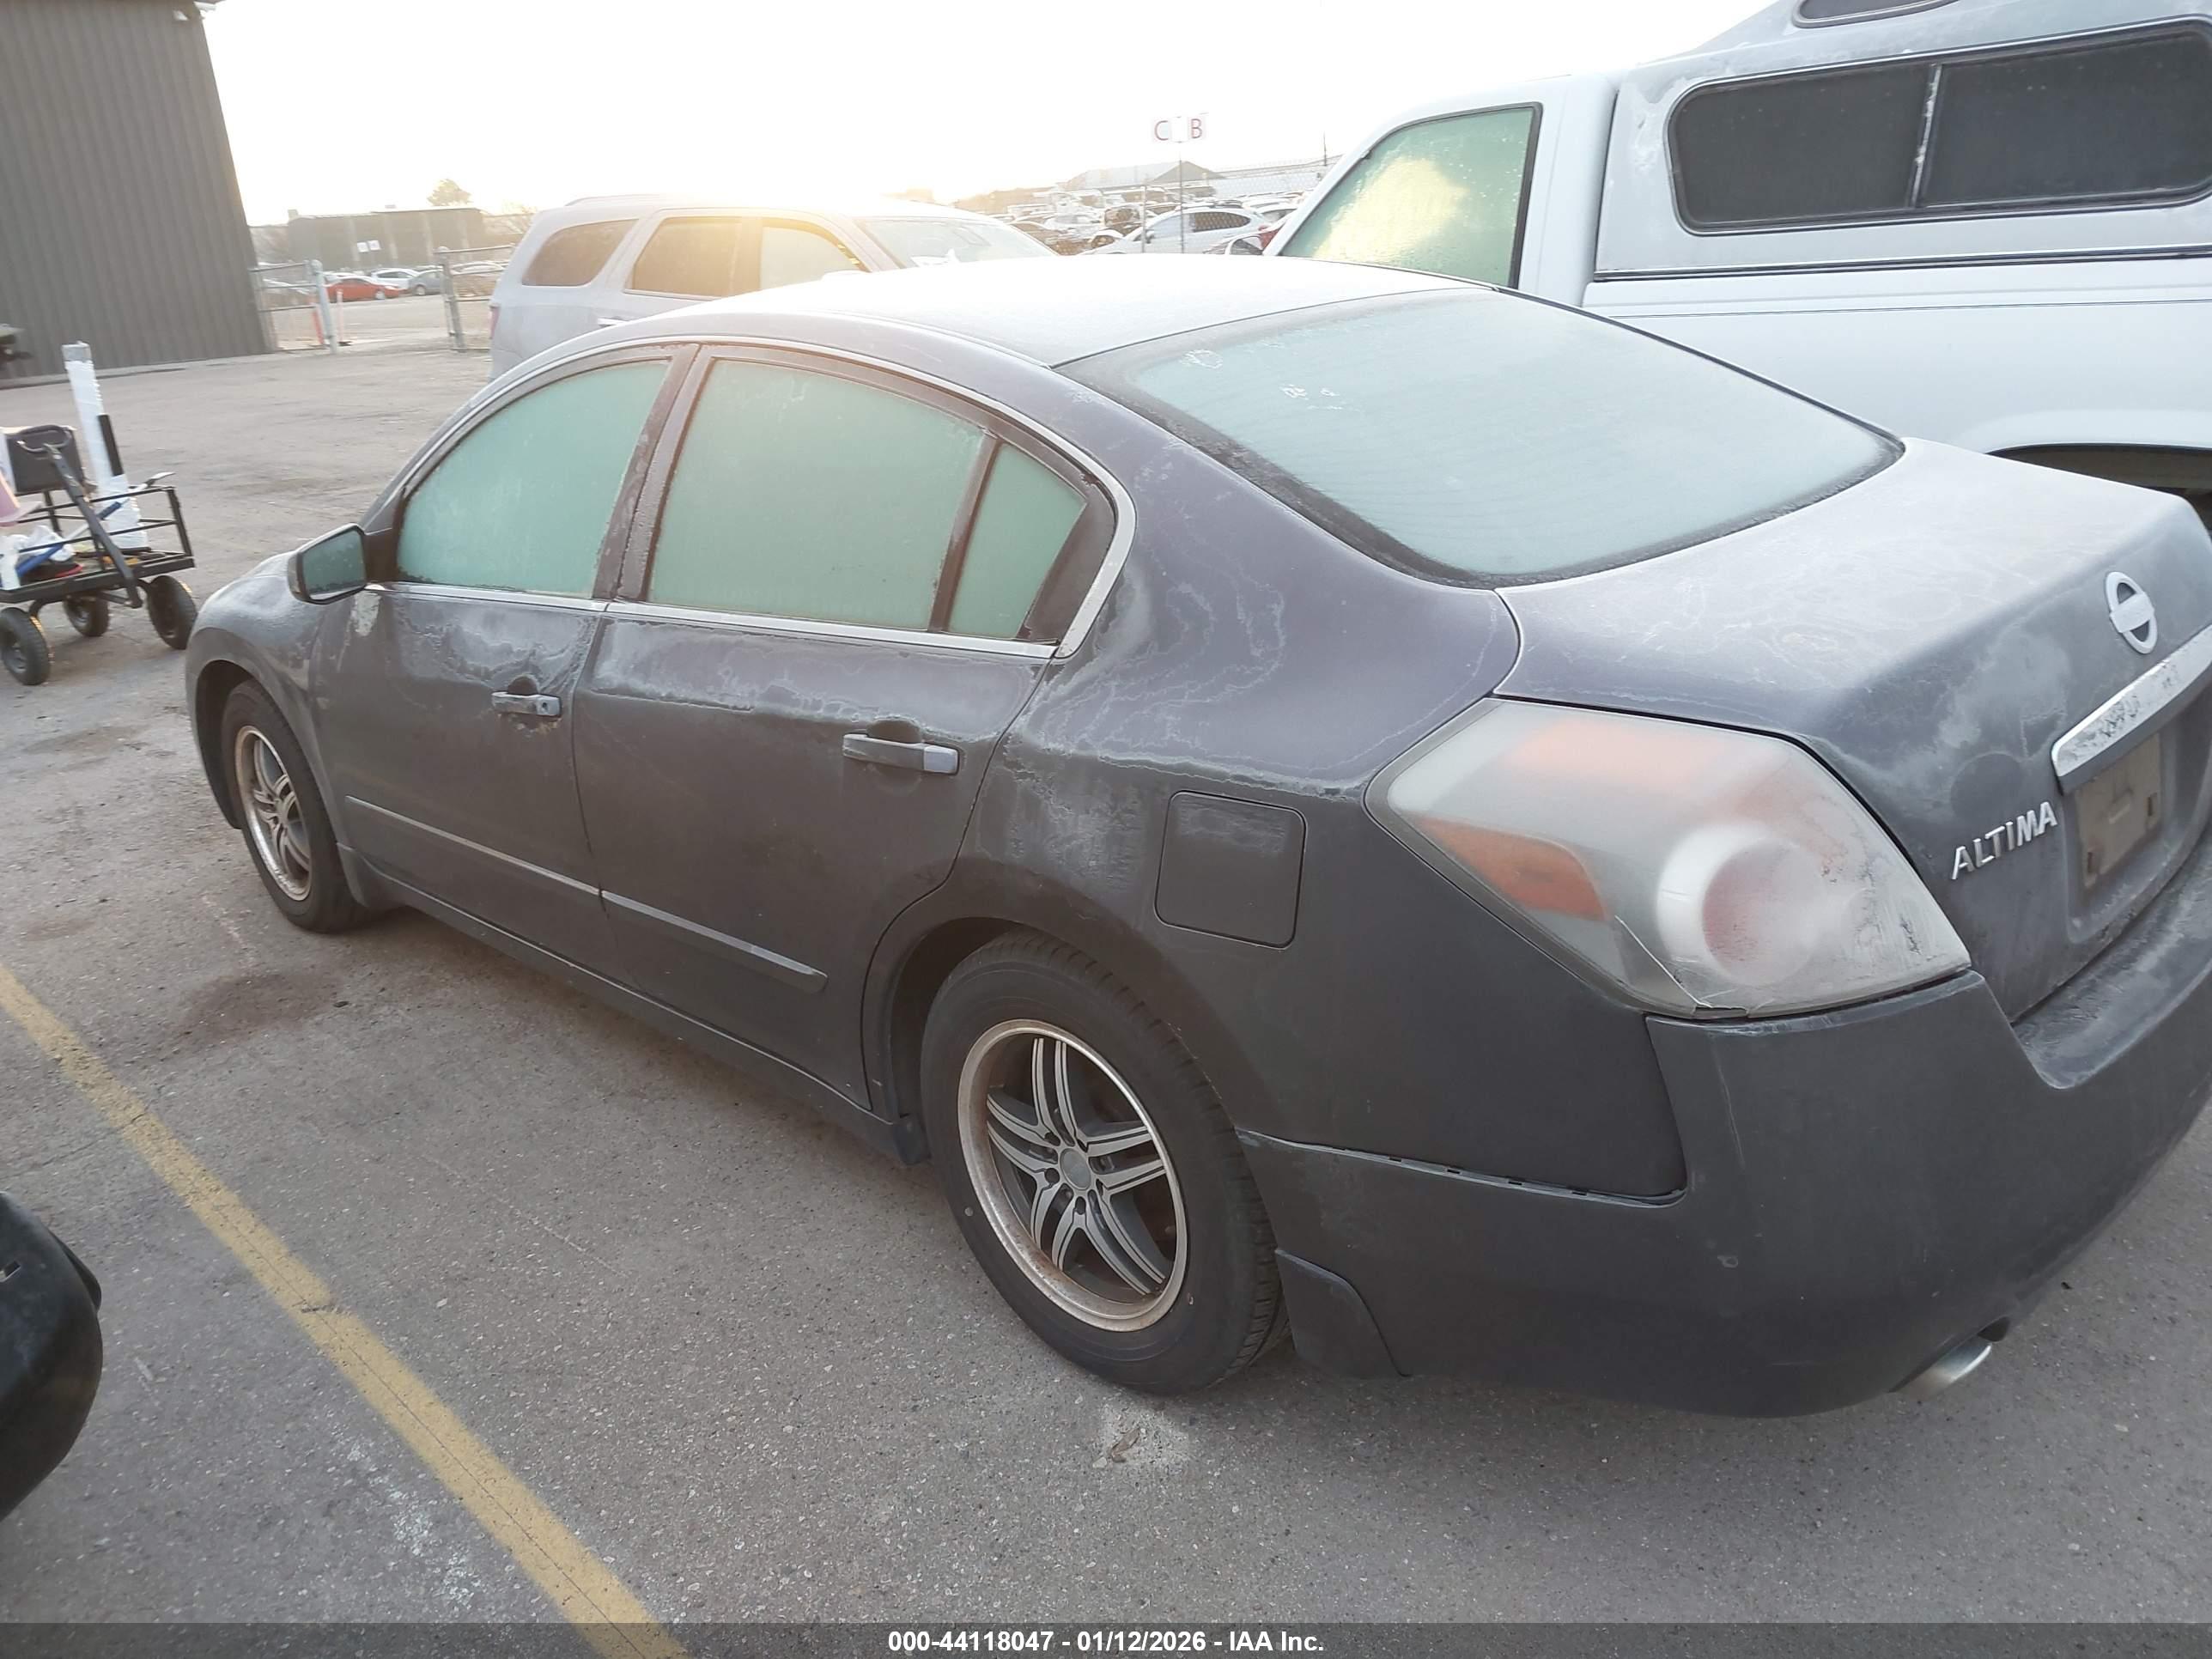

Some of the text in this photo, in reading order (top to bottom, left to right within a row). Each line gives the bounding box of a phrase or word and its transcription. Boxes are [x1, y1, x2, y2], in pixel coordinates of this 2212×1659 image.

[1153, 119, 1169, 141] C
[1190, 118, 1203, 139] B
[1951, 801, 2058, 880] ALTIMA
